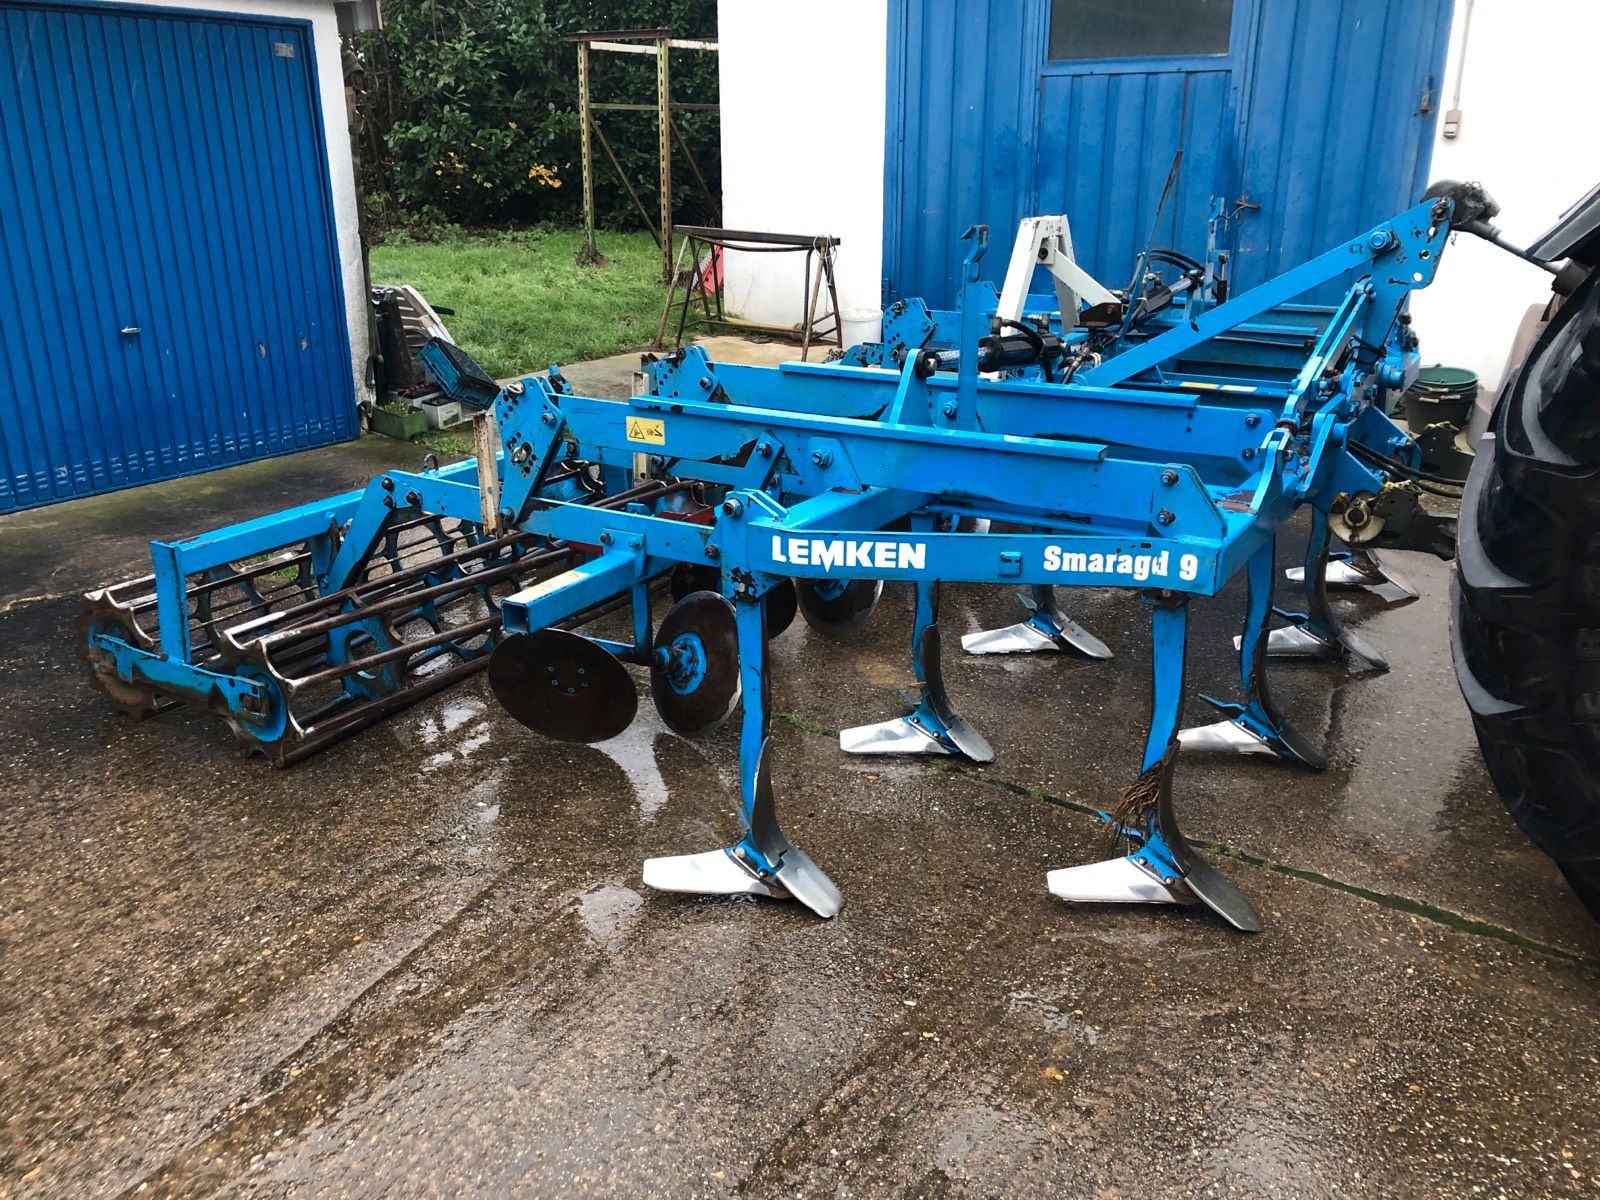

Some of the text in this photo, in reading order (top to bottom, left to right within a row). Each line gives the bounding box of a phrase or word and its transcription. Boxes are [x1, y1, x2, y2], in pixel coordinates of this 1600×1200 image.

[771, 536, 926, 572] LEMKEN
[1043, 545, 1198, 581] Smaragd 9
